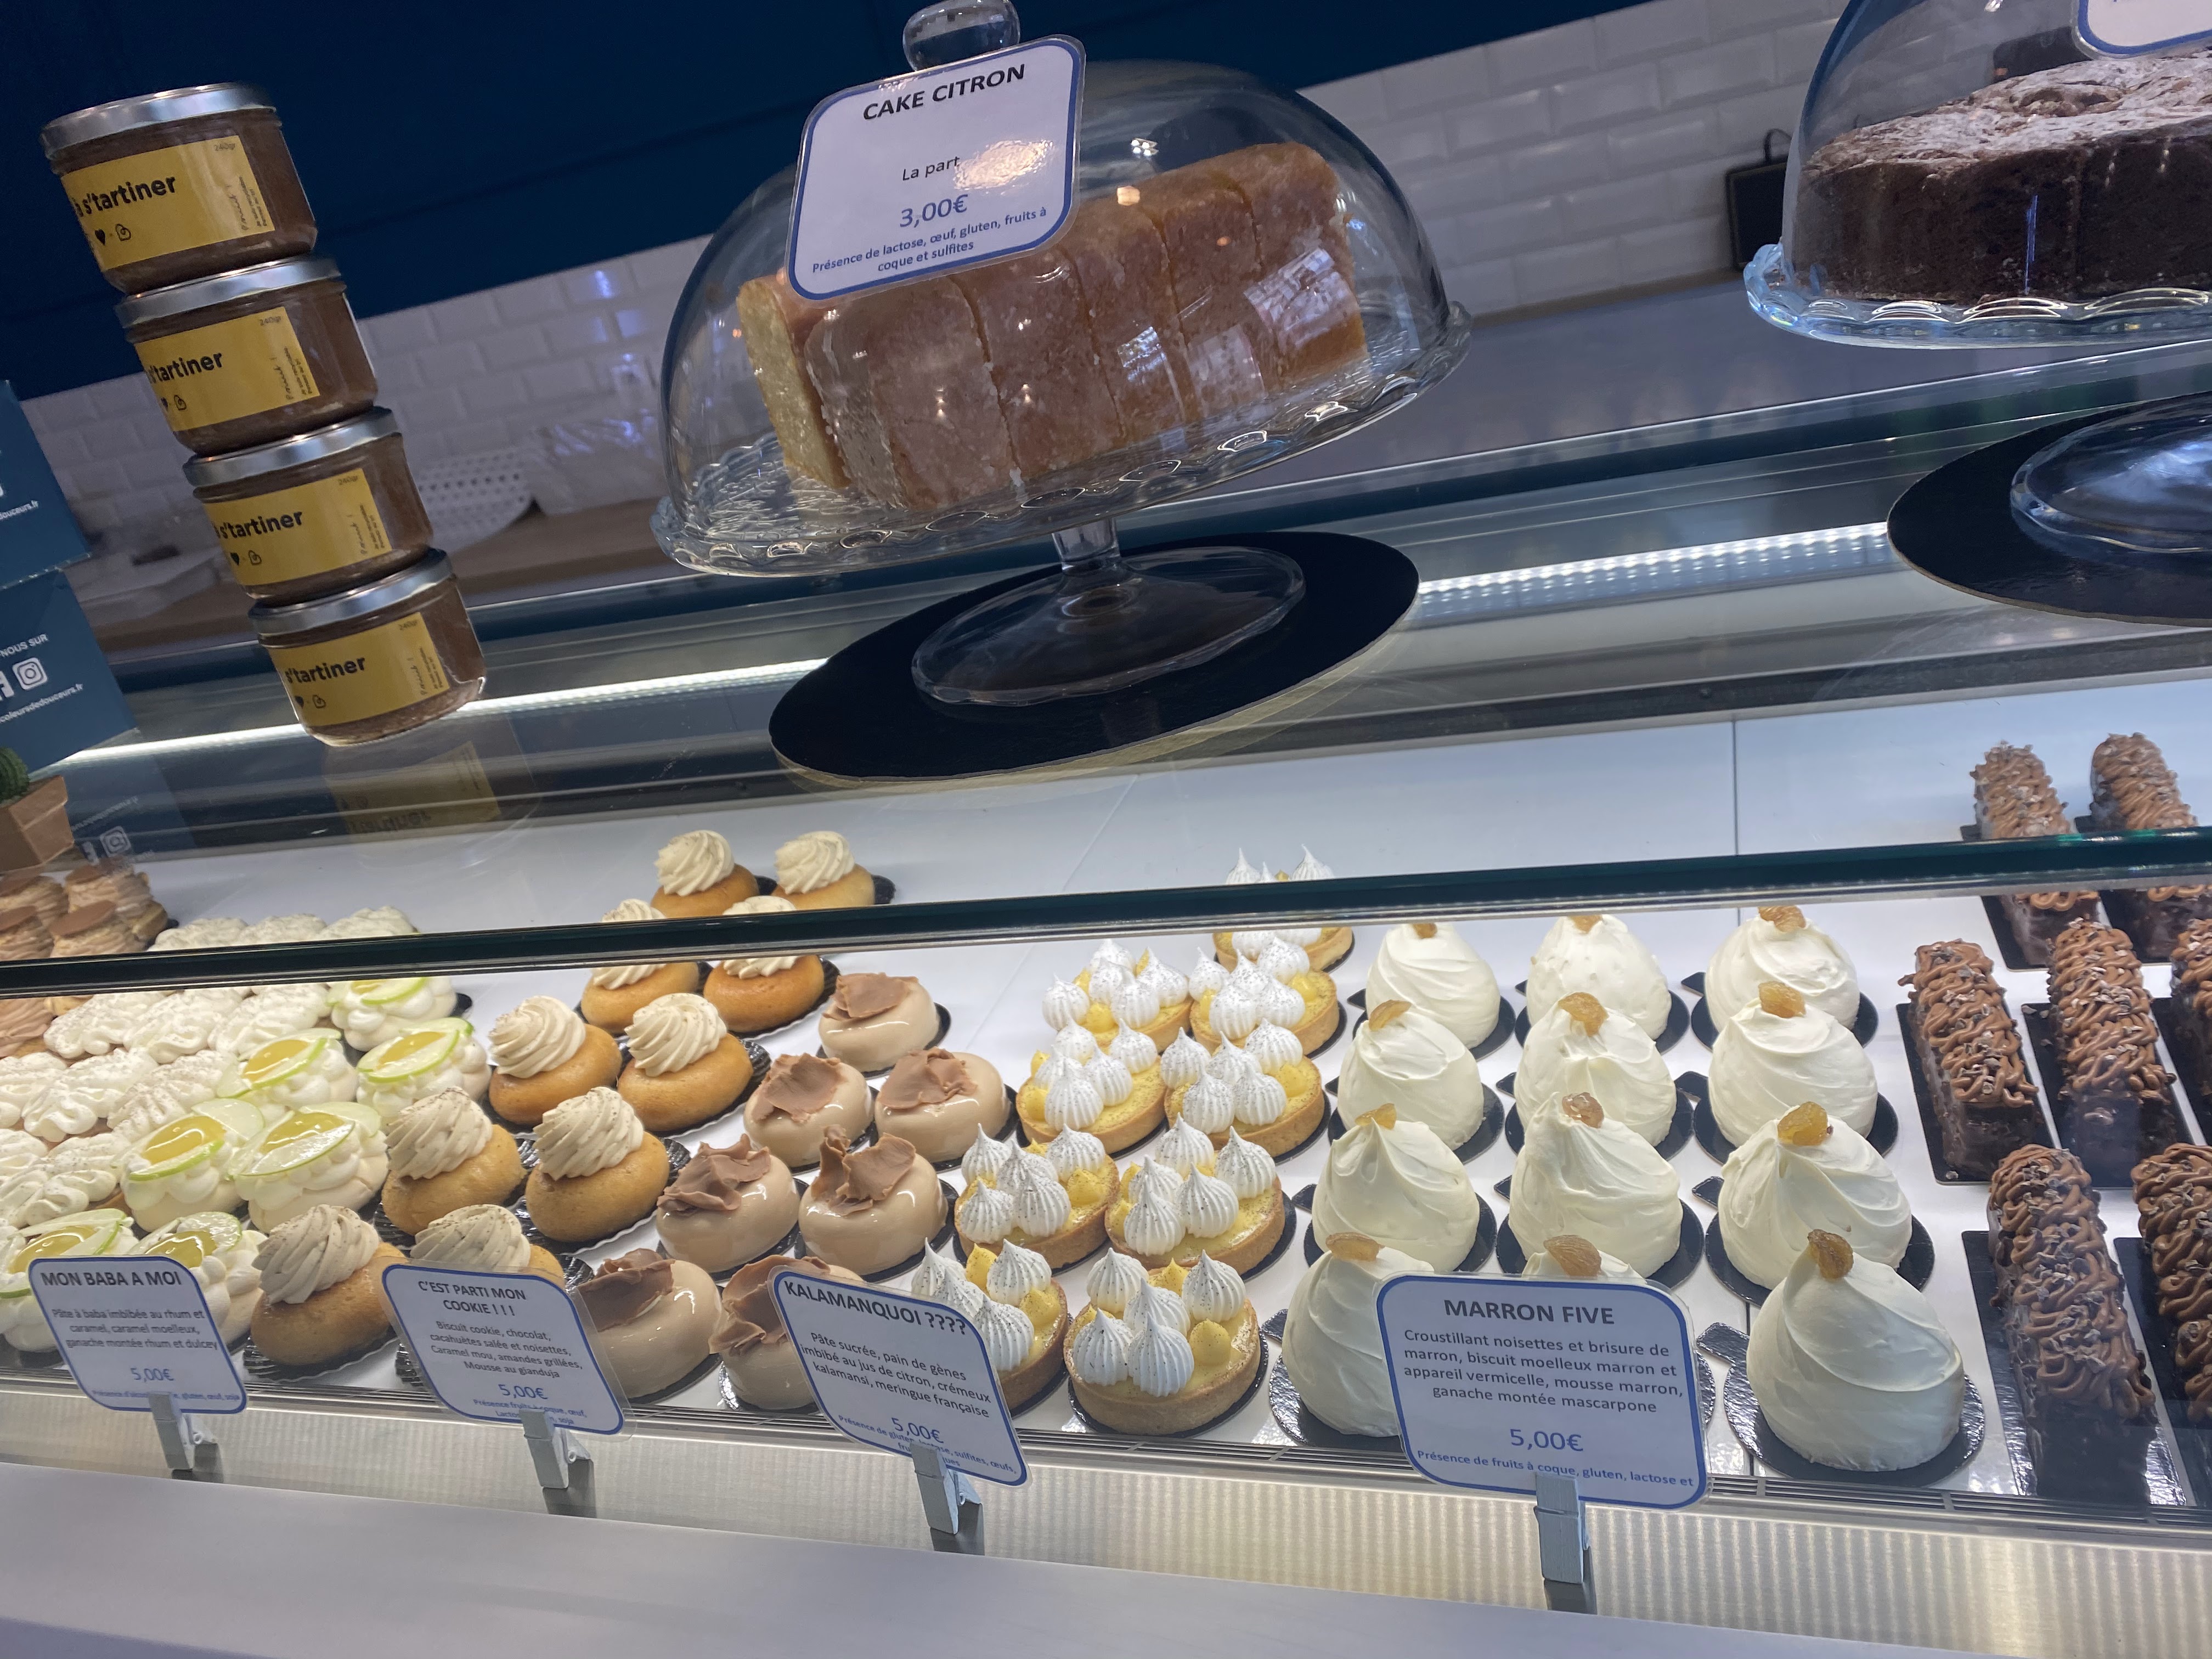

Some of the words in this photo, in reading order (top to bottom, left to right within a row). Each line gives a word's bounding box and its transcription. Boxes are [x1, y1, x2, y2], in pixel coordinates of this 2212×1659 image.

[864, 91, 925, 120] CAKE
[932, 64, 1025, 103] CITRON
[902, 168, 918, 180] La
[925, 156, 960, 179] part
[82, 176, 175, 214] s'tartiner
[899, 194, 969, 228] 3,00€
[812, 252, 863, 273] Présence
[865, 246, 879, 259] de
[883, 238, 927, 257] lactose,
[930, 228, 957, 245] œuf,
[960, 219, 1001, 239] gluten,
[1005, 210, 1036, 227] fruits
[1039, 206, 1047, 217] à
[878, 255, 913, 273] coque
[916, 251, 929, 262] et
[931, 241, 974, 260] sulfites
[28, 634, 49, 647] SUR
[40, 1272, 82, 1285] MON
[83, 1272, 128, 1285] BABA
[131, 1272, 144, 1285] A
[144, 1271, 182, 1285] MOI
[418, 1281, 450, 1294] C'EST
[453, 1284, 489, 1297] PARTI
[490, 1288, 527, 1300] MON
[74, 1309, 82, 1318] à
[82, 1309, 108, 1318] baba
[164, 1310, 191, 1318] rhum
[443, 1300, 491, 1314] COOKIE
[784, 1280, 922, 1325] KALAMANQUOI
[924, 1312, 966, 1335] ????
[1444, 1299, 1555, 1322] MARRON
[1561, 1306, 1615, 1324] FIVE
[111, 1324, 150, 1333] caramel
[150, 1324, 200, 1335] moelleux,
[436, 1321, 469, 1332] Biscuit
[470, 1326, 504, 1337] cookie,
[506, 1329, 551, 1341] chocolat,
[65, 1339, 106, 1348] ganache
[106, 1339, 143, 1347] montée
[144, 1339, 172, 1347] rhum
[185, 1339, 218, 1350] dulcey
[430, 1334, 482, 1346] cacahuètes
[483, 1340, 509, 1349] salée
[523, 1344, 571, 1356] noisettes,
[810, 1331, 836, 1348] Pâte
[838, 1340, 881, 1361] sucrée,
[883, 1352, 909, 1368] pain
[911, 1357, 927, 1371] de
[929, 1363, 967, 1381] gènes
[1404, 1329, 1489, 1347] Croustillant
[1493, 1336, 1564, 1351] noisettes
[1567, 1341, 1585, 1352] et
[1589, 1340, 1644, 1356] brisure
[1649, 1344, 1669, 1357] de
[431, 1345, 470, 1357] Caramel
[471, 1351, 496, 1361] mou,
[498, 1355, 543, 1364] amandes
[544, 1358, 583, 1370] grillées,
[464, 1361, 502, 1372] Mousse
[518, 1367, 560, 1379] gianduja
[1404, 1349, 1463, 1364] marron,
[1468, 1351, 1517, 1367] biscuit
[1520, 1357, 1592, 1372] moelleux
[1596, 1362, 1655, 1375] marron
[1661, 1364, 1677, 1377] et
[130, 1368, 175, 1383] 5,00€
[800, 1344, 840, 1363] imbibé
[843, 1356, 856, 1368] au
[857, 1358, 876, 1373] jus
[878, 1364, 894, 1378] de
[896, 1369, 935, 1389] citron,
[937, 1382, 991, 1403] crémeux
[1404, 1365, 1463, 1381] appareil
[1466, 1372, 1550, 1390] vermicelle,
[1554, 1379, 1614, 1392] mousse
[1619, 1383, 1684, 1398] marron,
[498, 1384, 549, 1400] 5,00€
[812, 1361, 874, 1387] kalamansi,
[876, 1379, 932, 1402] meringue
[933, 1393, 989, 1418] française
[1432, 1386, 1493, 1401] ganache
[1498, 1391, 1557, 1406] montée
[1561, 1397, 1657, 1414] mascarpone
[891, 1417, 944, 1444] 5,00€
[1510, 1428, 1584, 1453] 5,00€
[838, 1414, 875, 1432] Présence
[877, 1426, 888, 1436] de
[954, 1451, 989, 1466] sulfites,
[990, 1460, 1017, 1474] œufs,
[1418, 1450, 1471, 1465] Présence
[1474, 1455, 1489, 1466] de
[1492, 1457, 1525, 1470] fruits
[1527, 1460, 1534, 1471] à
[1537, 1464, 1580, 1477] coque,
[1582, 1466, 1627, 1482] gluten,
[1630, 1471, 1677, 1486] lactose
[1680, 1475, 1695, 1486] et
